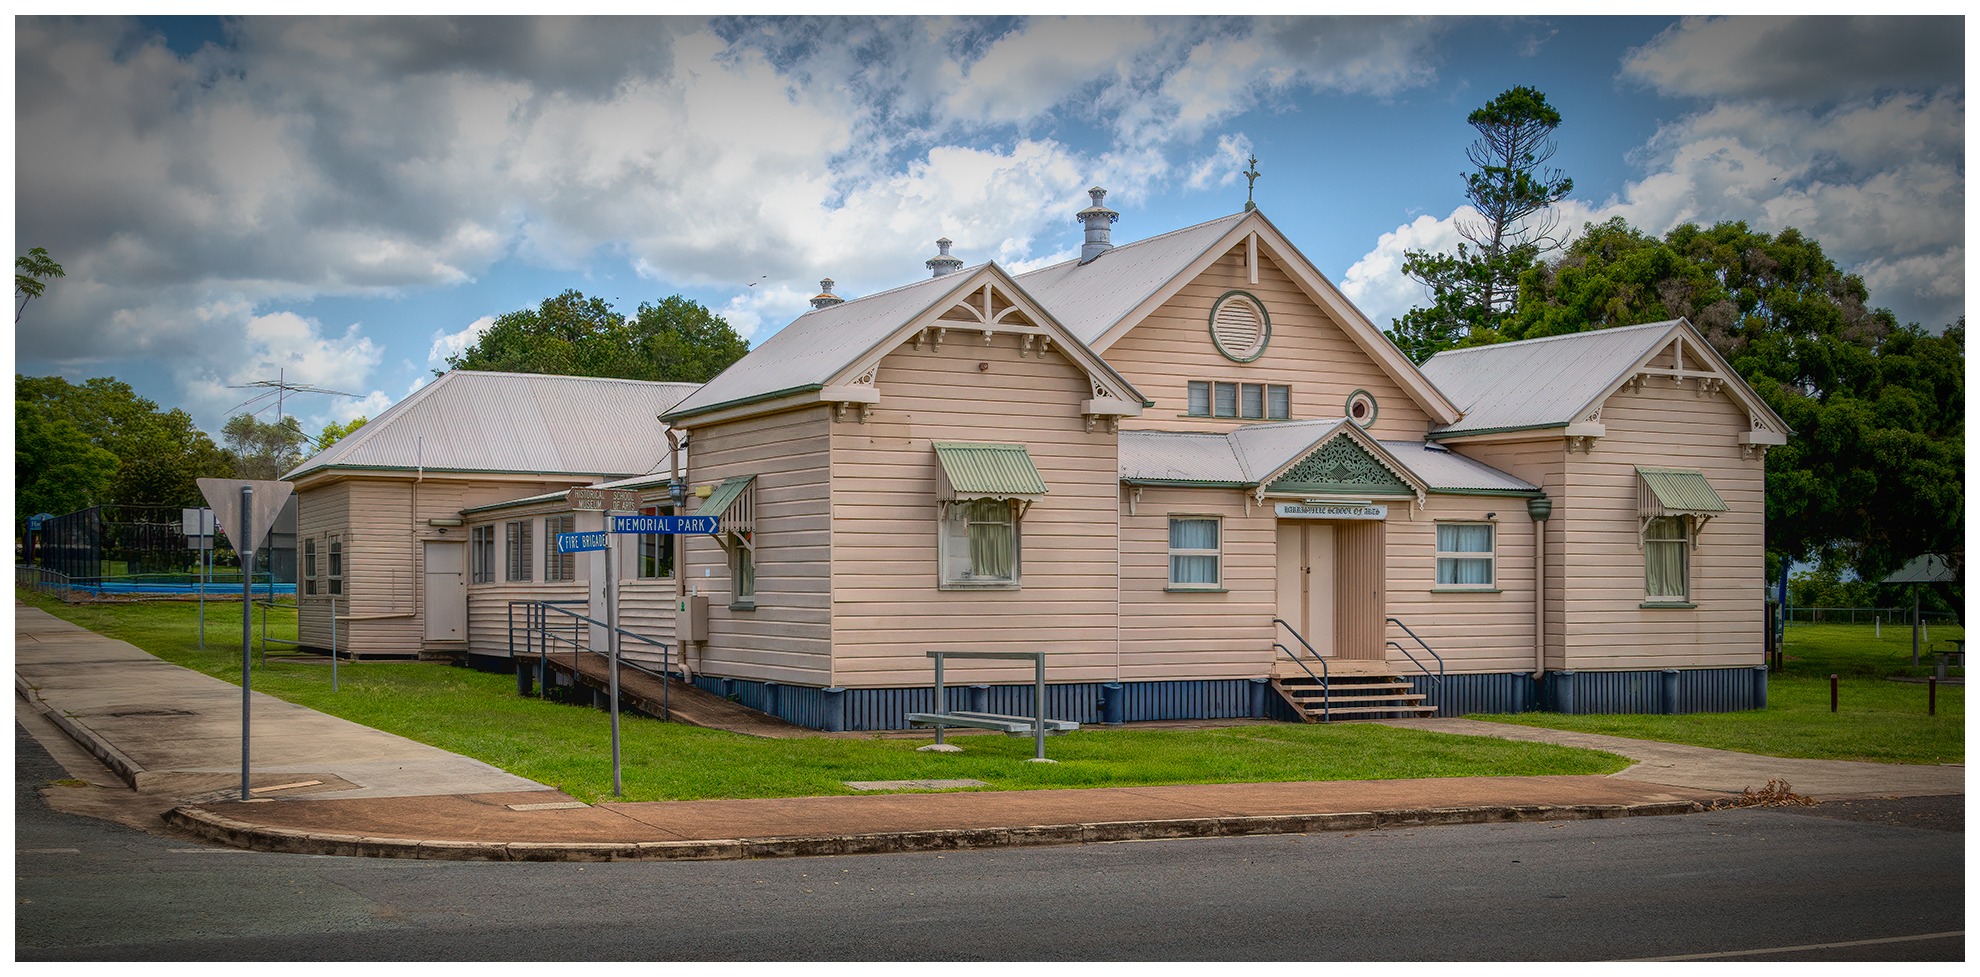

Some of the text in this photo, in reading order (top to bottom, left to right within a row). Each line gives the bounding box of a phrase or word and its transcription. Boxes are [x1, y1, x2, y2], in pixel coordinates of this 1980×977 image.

[574, 489, 605, 500] HISTORICAL
[612, 491, 634, 502] SCHOOL
[578, 499, 602, 509] MUSEUM
[612, 501, 635, 511] OF ARTS
[1327, 506, 1352, 515] SCHOOL
[617, 518, 705, 532] MEMORIAL PARK
[565, 534, 606, 549] FIRE BRIGADE
